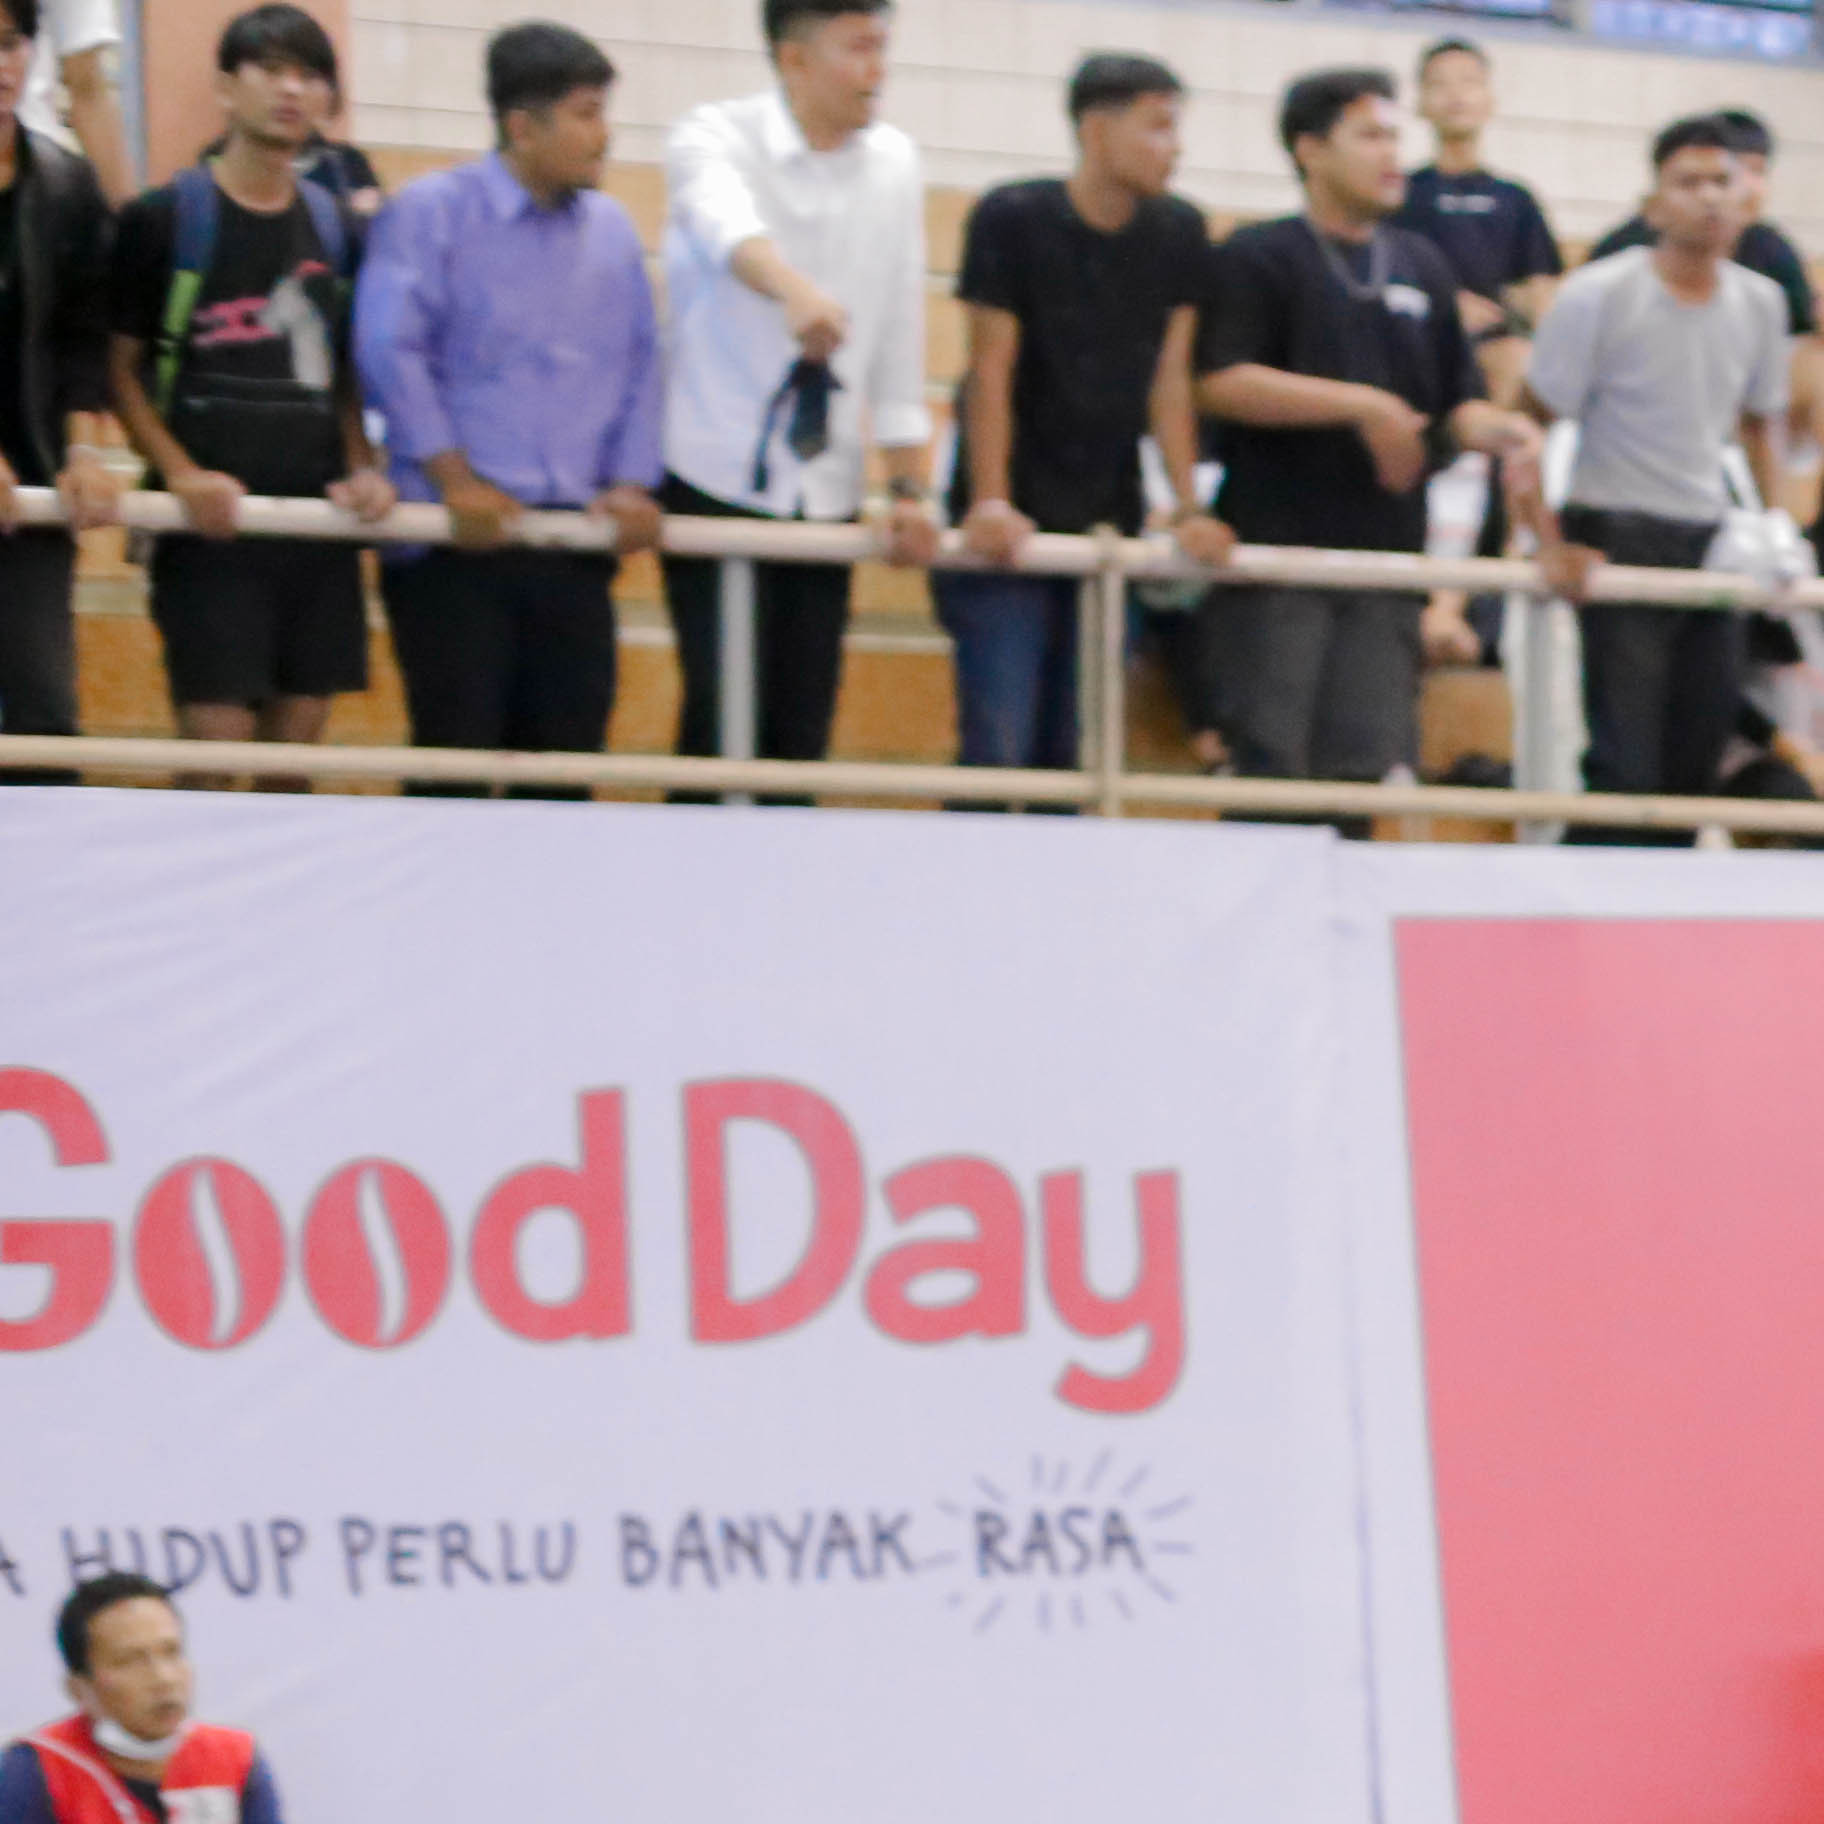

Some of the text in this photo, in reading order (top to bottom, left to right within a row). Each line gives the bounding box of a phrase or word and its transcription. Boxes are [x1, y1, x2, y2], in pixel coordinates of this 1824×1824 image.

[0, 1065, 1190, 1415] Good Day
[61, 1517, 307, 1600] HIDUP
[339, 1515, 577, 1597] PERLU
[617, 1506, 916, 1590] BANYAK
[971, 1506, 1149, 1579] RASA
